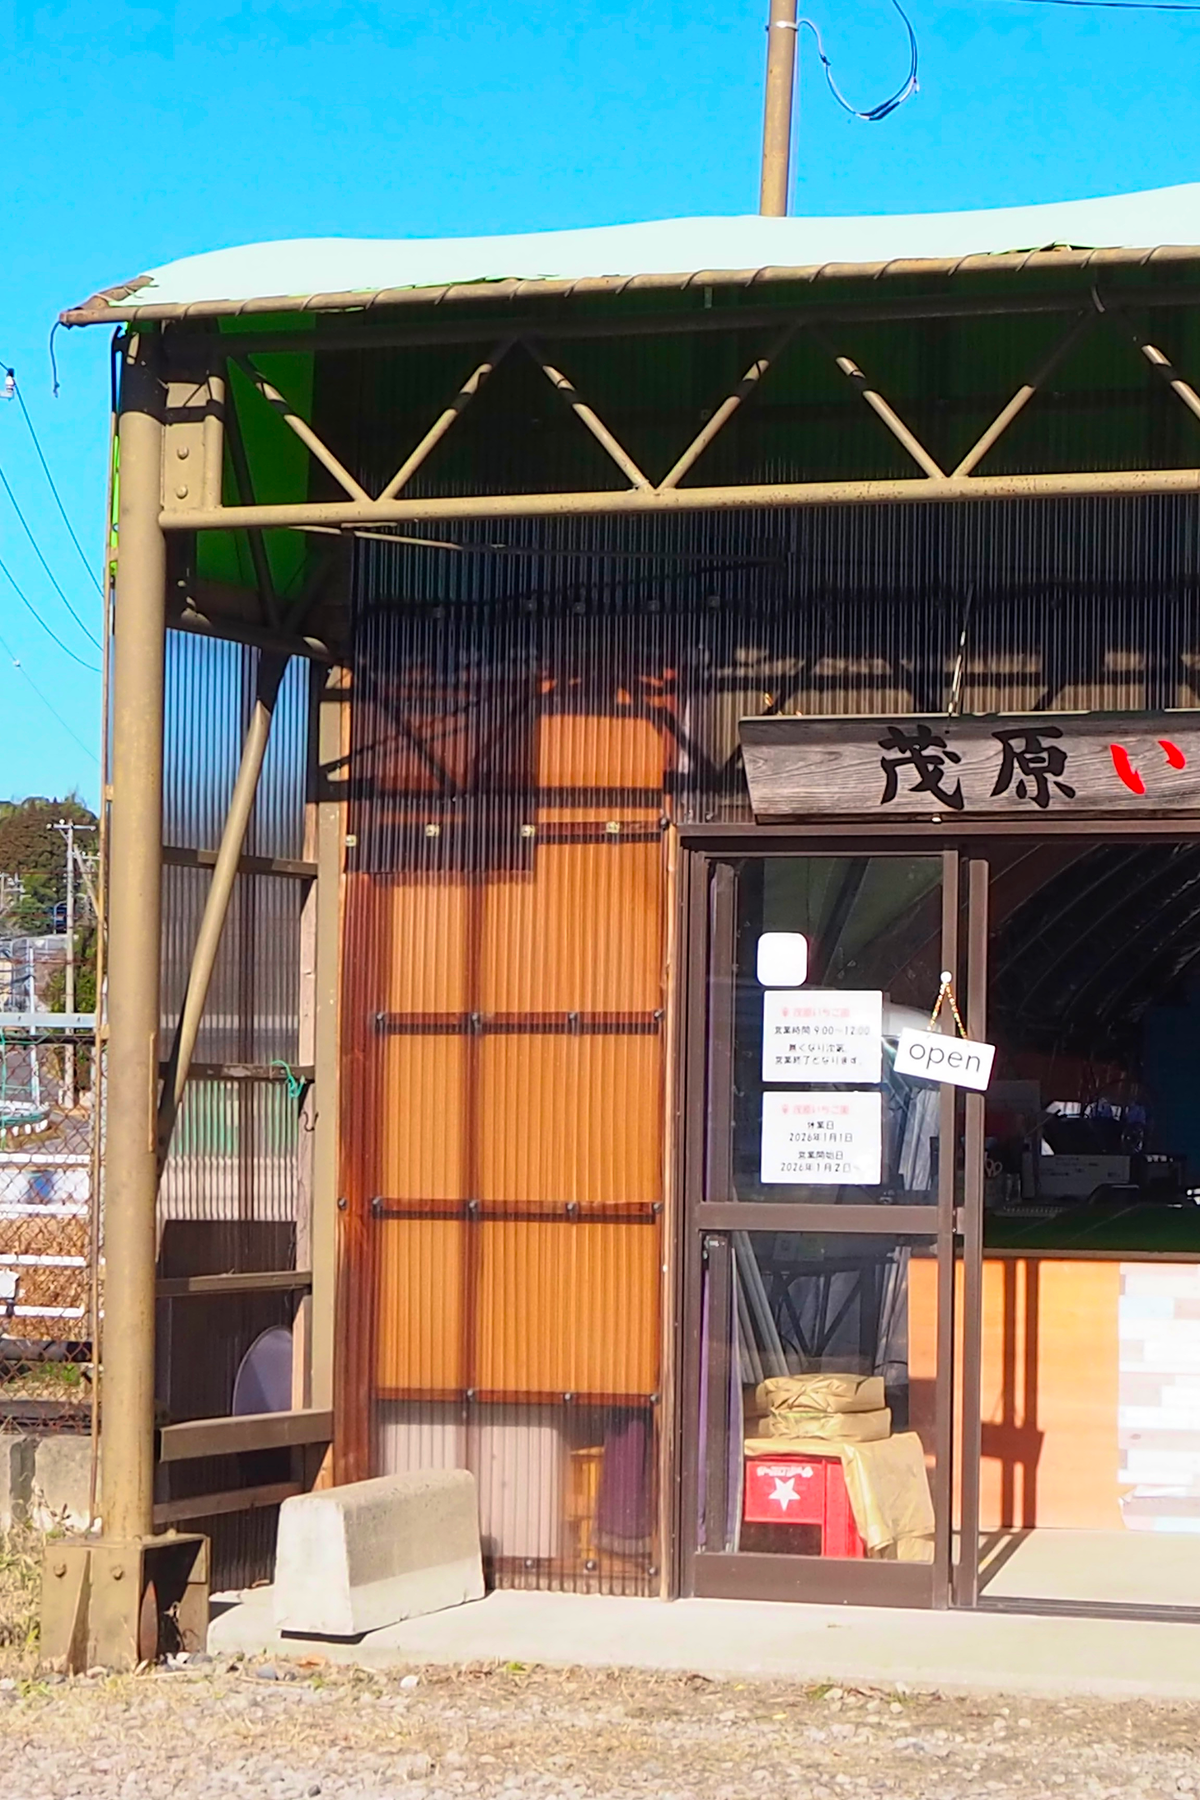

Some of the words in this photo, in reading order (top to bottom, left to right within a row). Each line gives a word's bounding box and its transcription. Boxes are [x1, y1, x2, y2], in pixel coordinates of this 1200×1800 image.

[909, 1044, 981, 1073] open
[789, 1132, 853, 1143] 2026年1月1日
